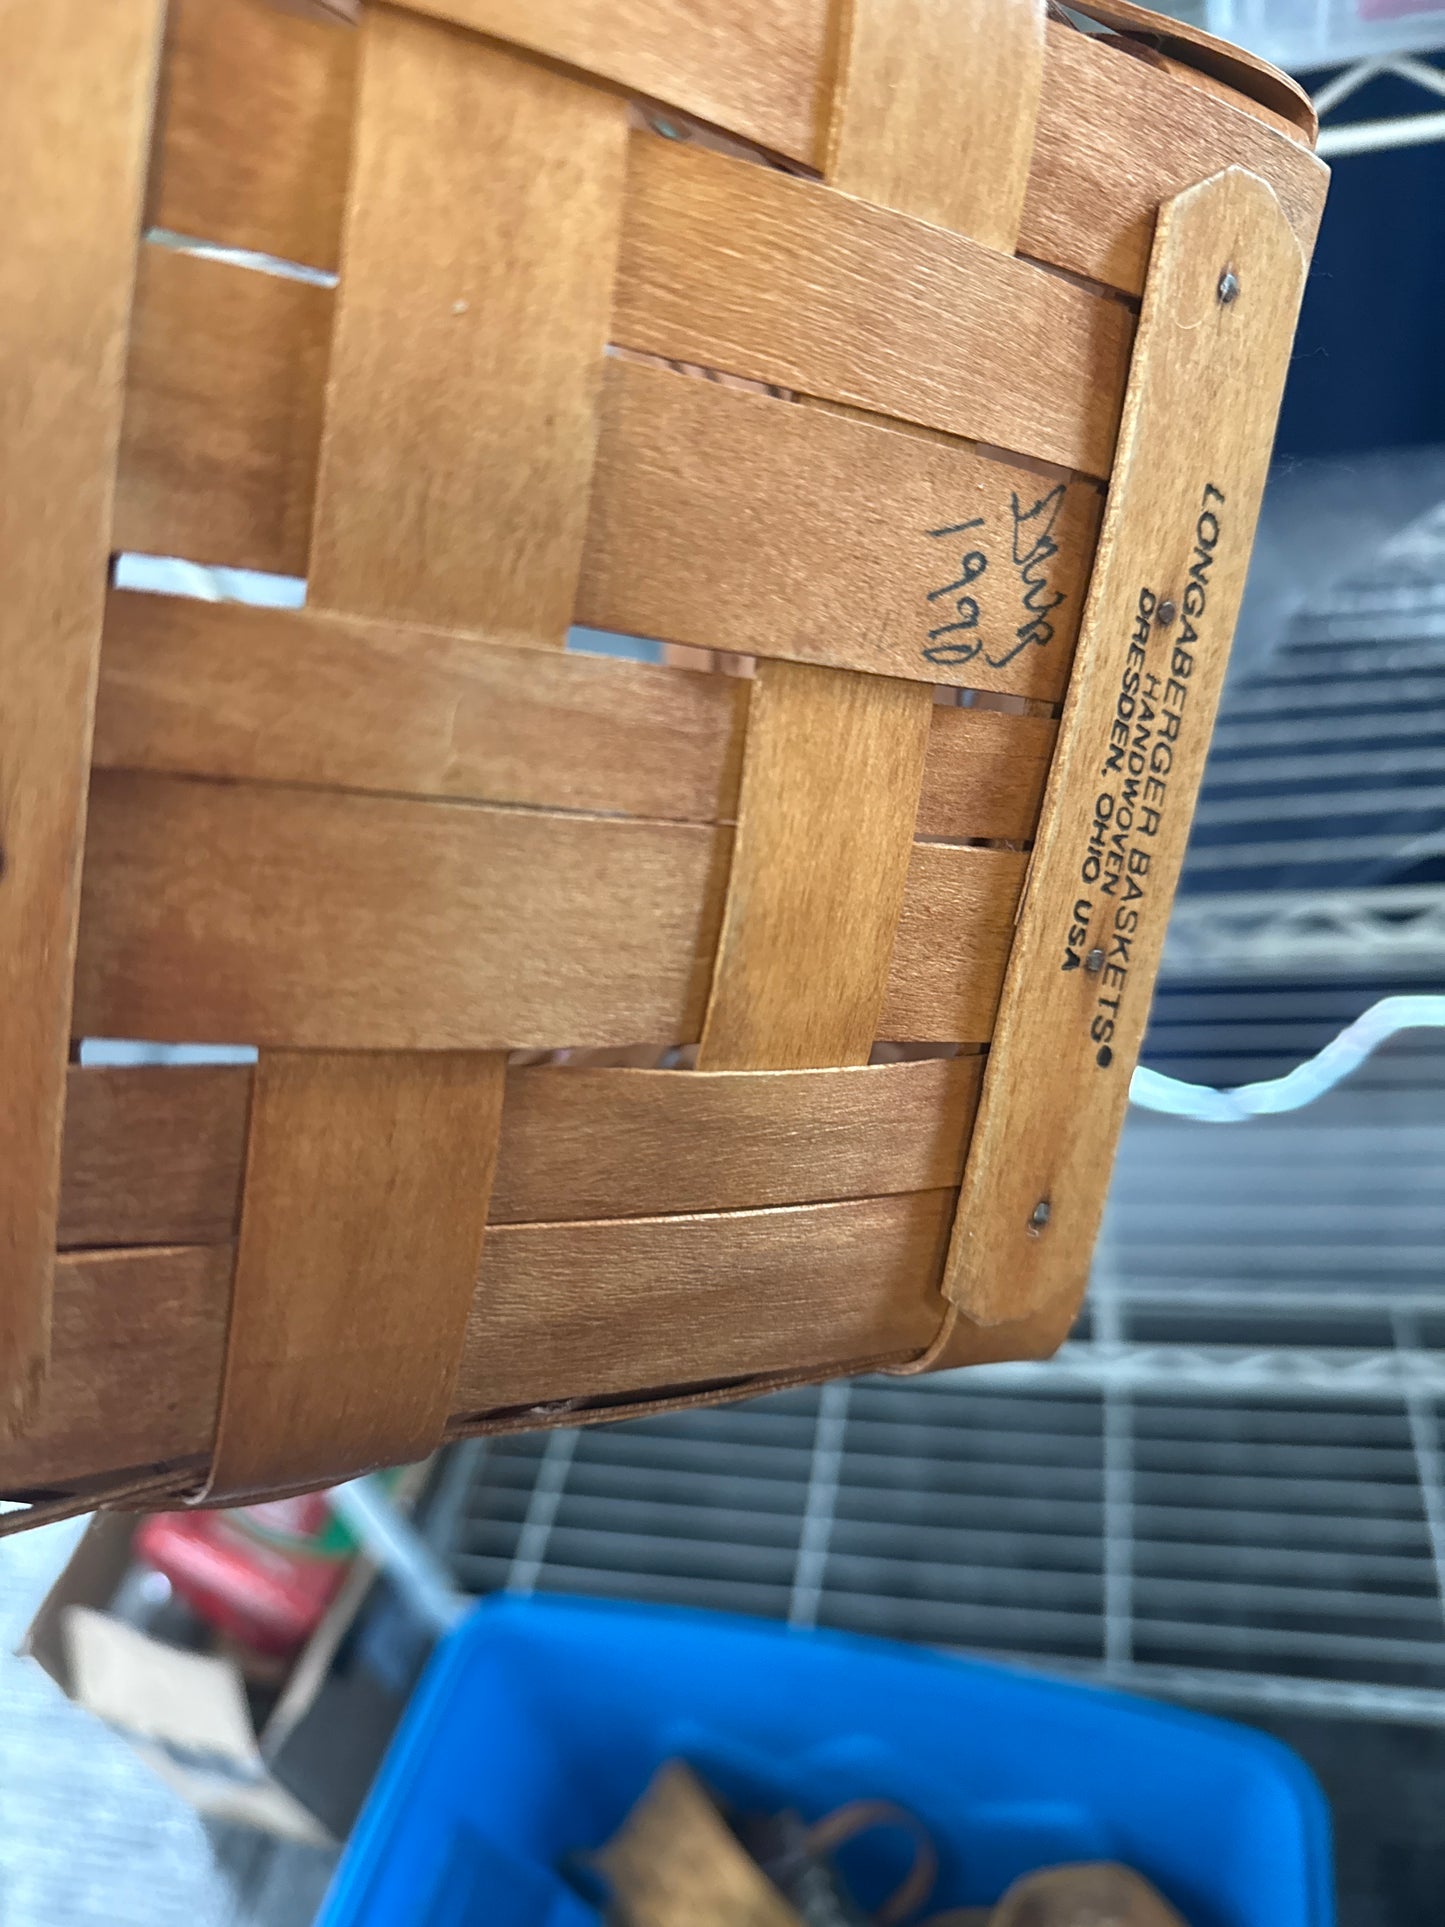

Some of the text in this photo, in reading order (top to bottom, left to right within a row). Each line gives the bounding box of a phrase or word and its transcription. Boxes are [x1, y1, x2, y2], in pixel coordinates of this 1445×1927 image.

[922, 517, 988, 665] 1990
[1138, 483, 1226, 838] LONGABERGER
[1081, 792, 1115, 884] OHIO
[1100, 673, 1163, 896] HANDWOVEN
[1061, 900, 1093, 972] USA
